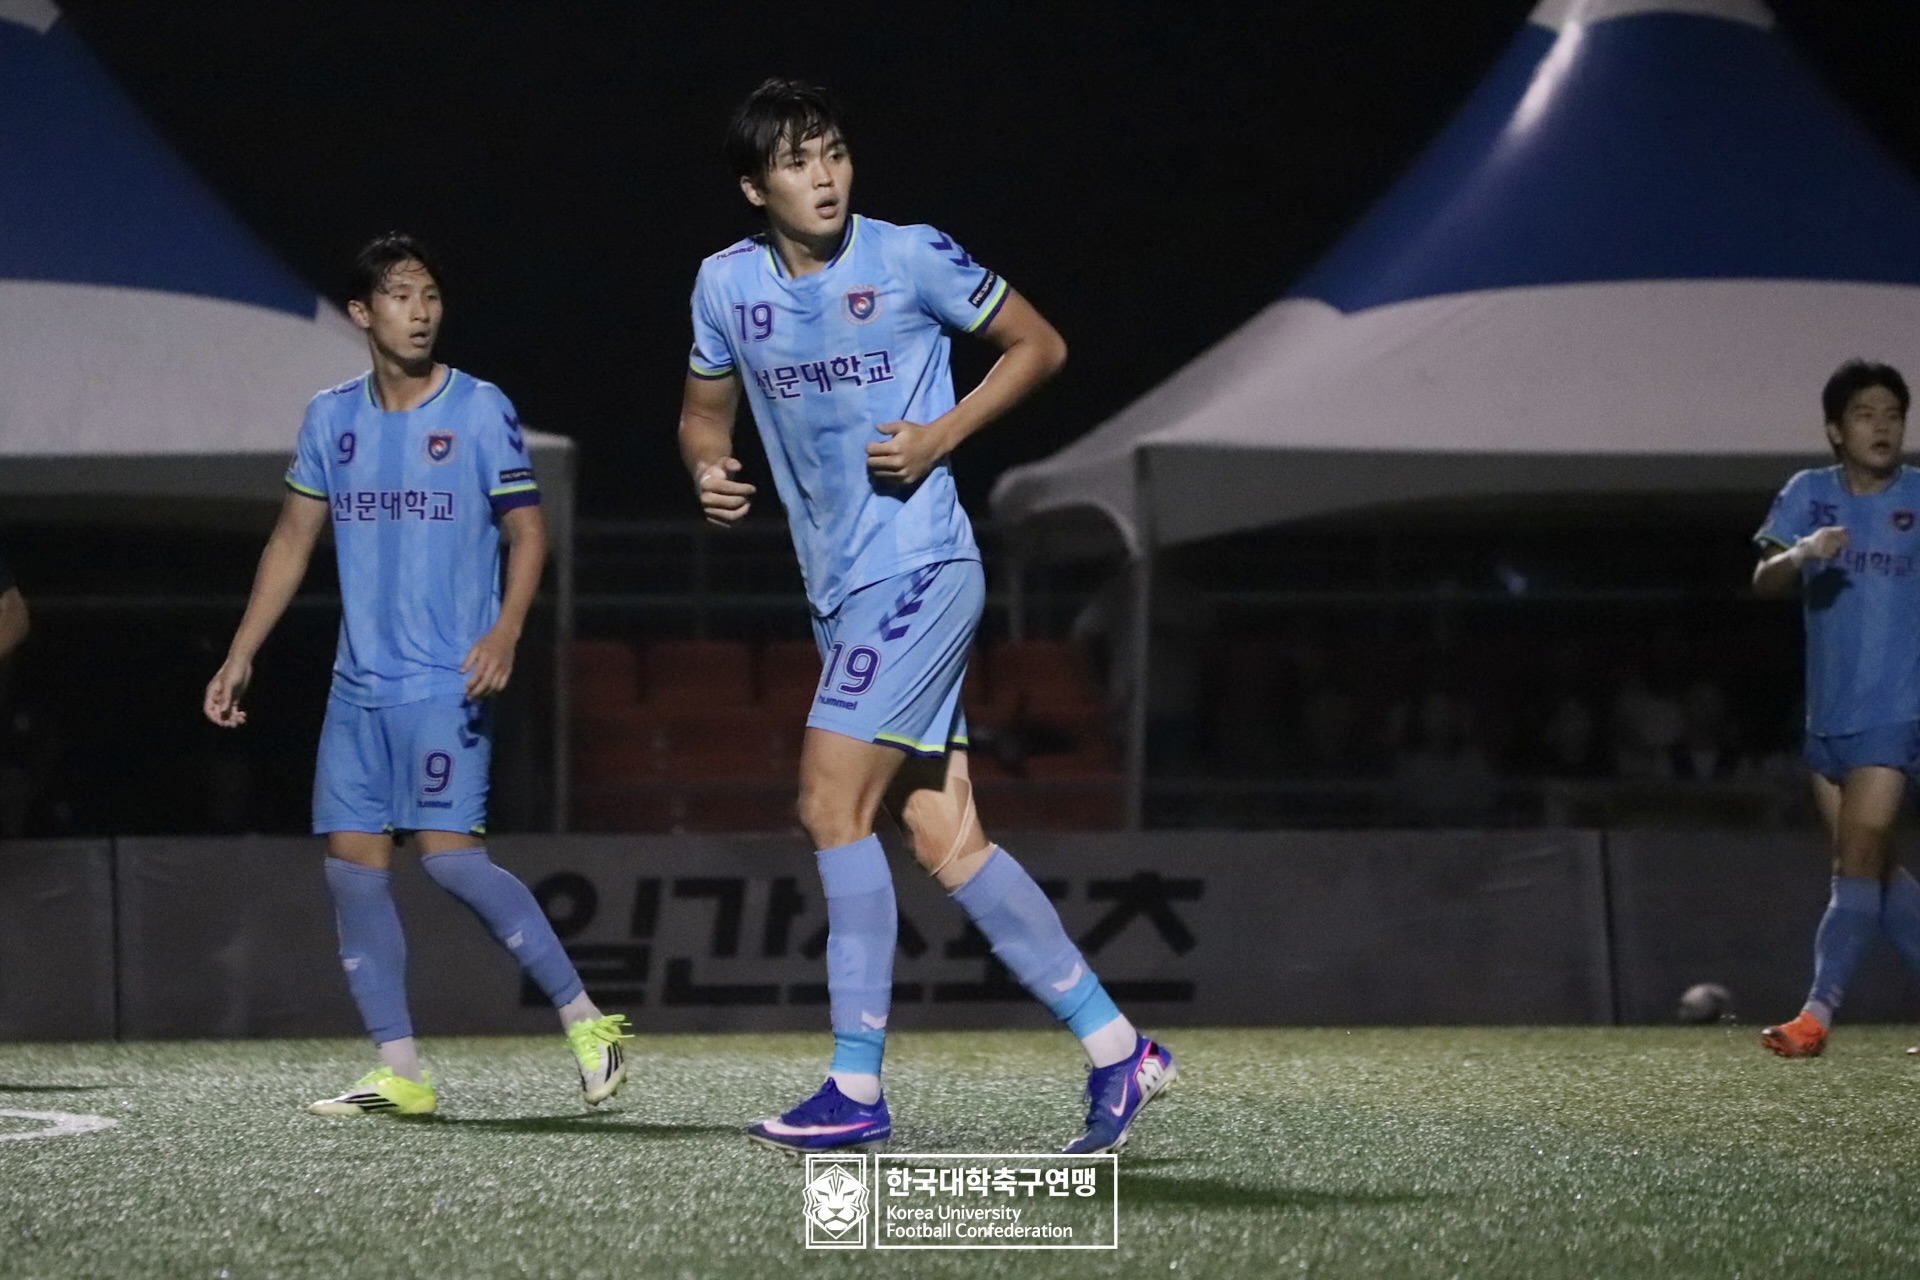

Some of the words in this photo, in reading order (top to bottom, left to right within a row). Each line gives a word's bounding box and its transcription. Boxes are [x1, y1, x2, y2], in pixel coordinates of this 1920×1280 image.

[733, 301, 775, 343] 19
[754, 350, 895, 401] 선문대학교
[337, 432, 357, 465] 9
[332, 489, 456, 522] 선문대학교
[823, 641, 881, 696] 19
[422, 750, 454, 795] 9
